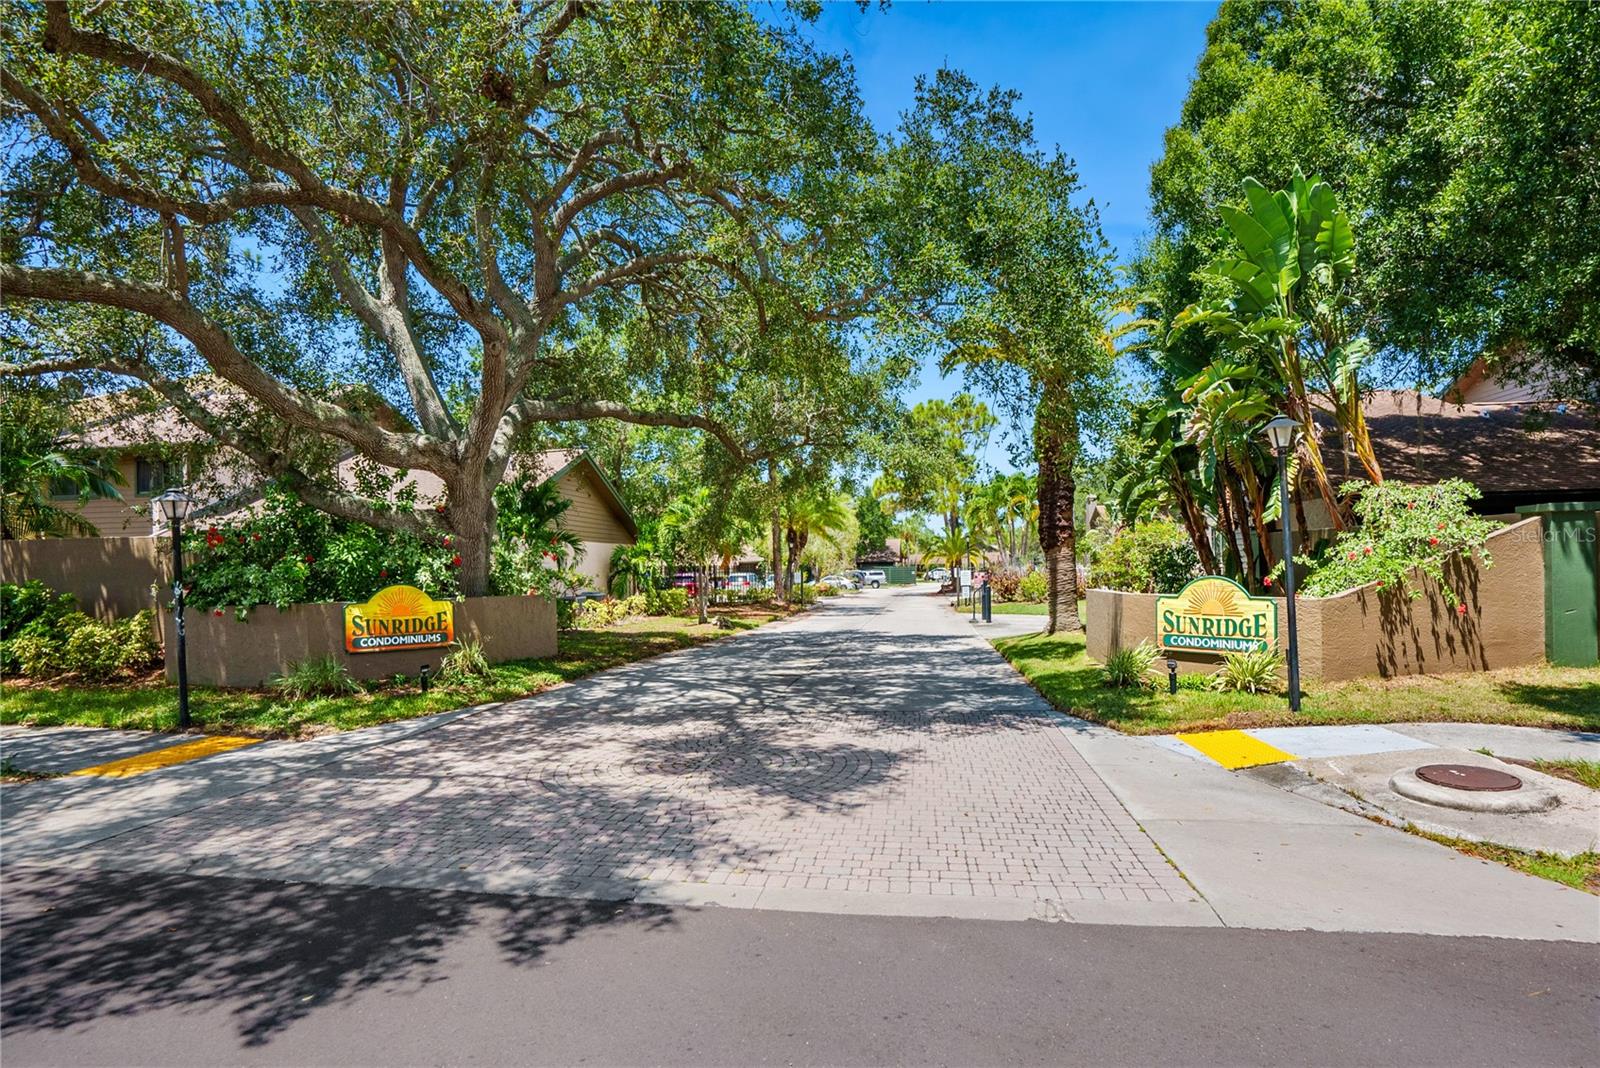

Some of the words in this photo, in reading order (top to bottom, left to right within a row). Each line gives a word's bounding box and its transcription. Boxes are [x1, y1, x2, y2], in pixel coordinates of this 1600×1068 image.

[352, 611, 447, 636] SUNRIDGE
[1163, 610, 1267, 638] SUNRIDGE
[360, 634, 441, 647] CONDOMINIUMS
